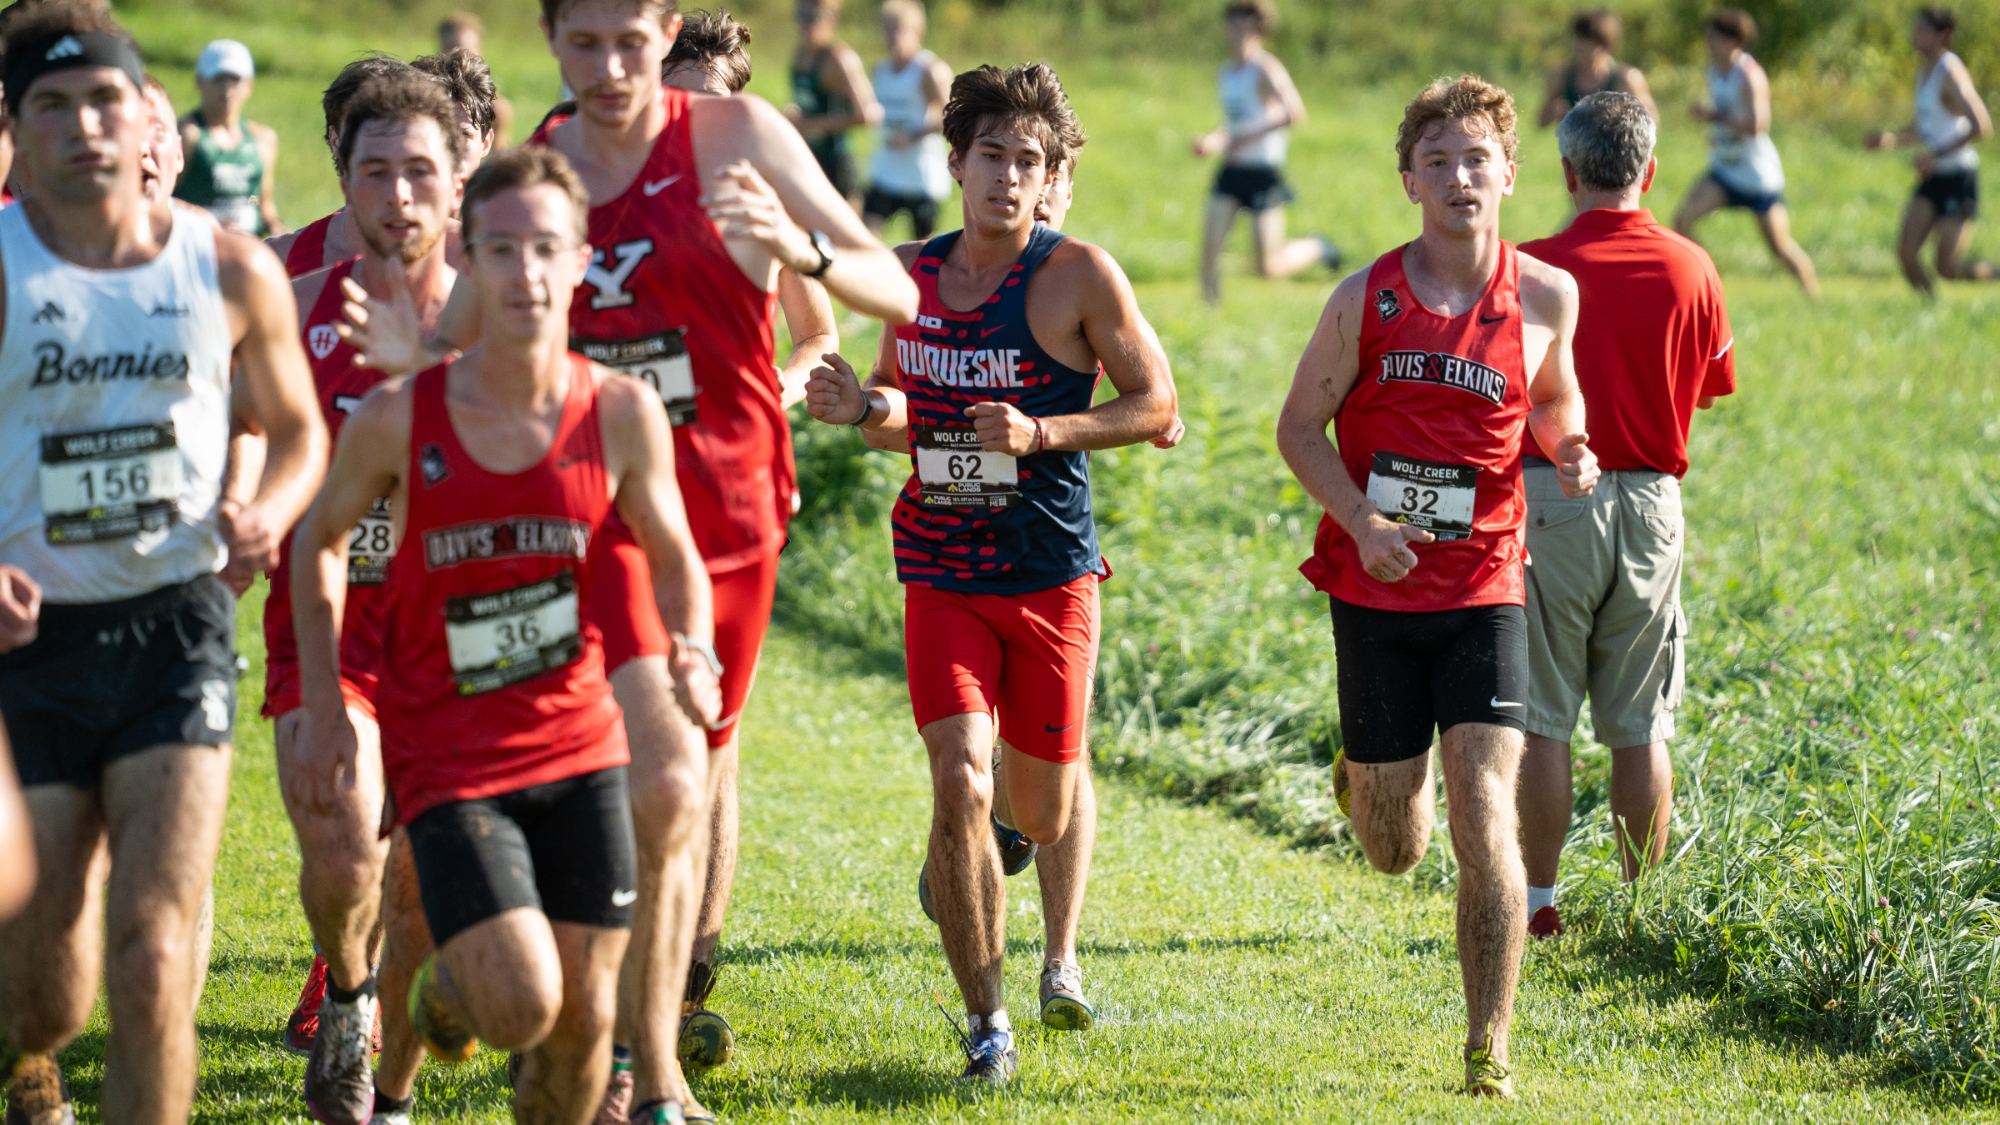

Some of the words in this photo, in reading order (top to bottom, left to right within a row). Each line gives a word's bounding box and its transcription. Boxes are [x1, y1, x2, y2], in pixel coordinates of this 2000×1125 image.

[584, 238, 653, 311] Y
[30, 340, 190, 390] Bonnies
[896, 338, 1024, 388] DUQUESNE
[933, 431, 961, 442] WOLF
[79, 463, 150, 500] 156
[948, 454, 983, 480] 62
[1392, 460, 1422, 475] WOLF
[1424, 467, 1460, 479] CREEK
[1401, 486, 1438, 515] 32
[495, 617, 541, 650] 36
